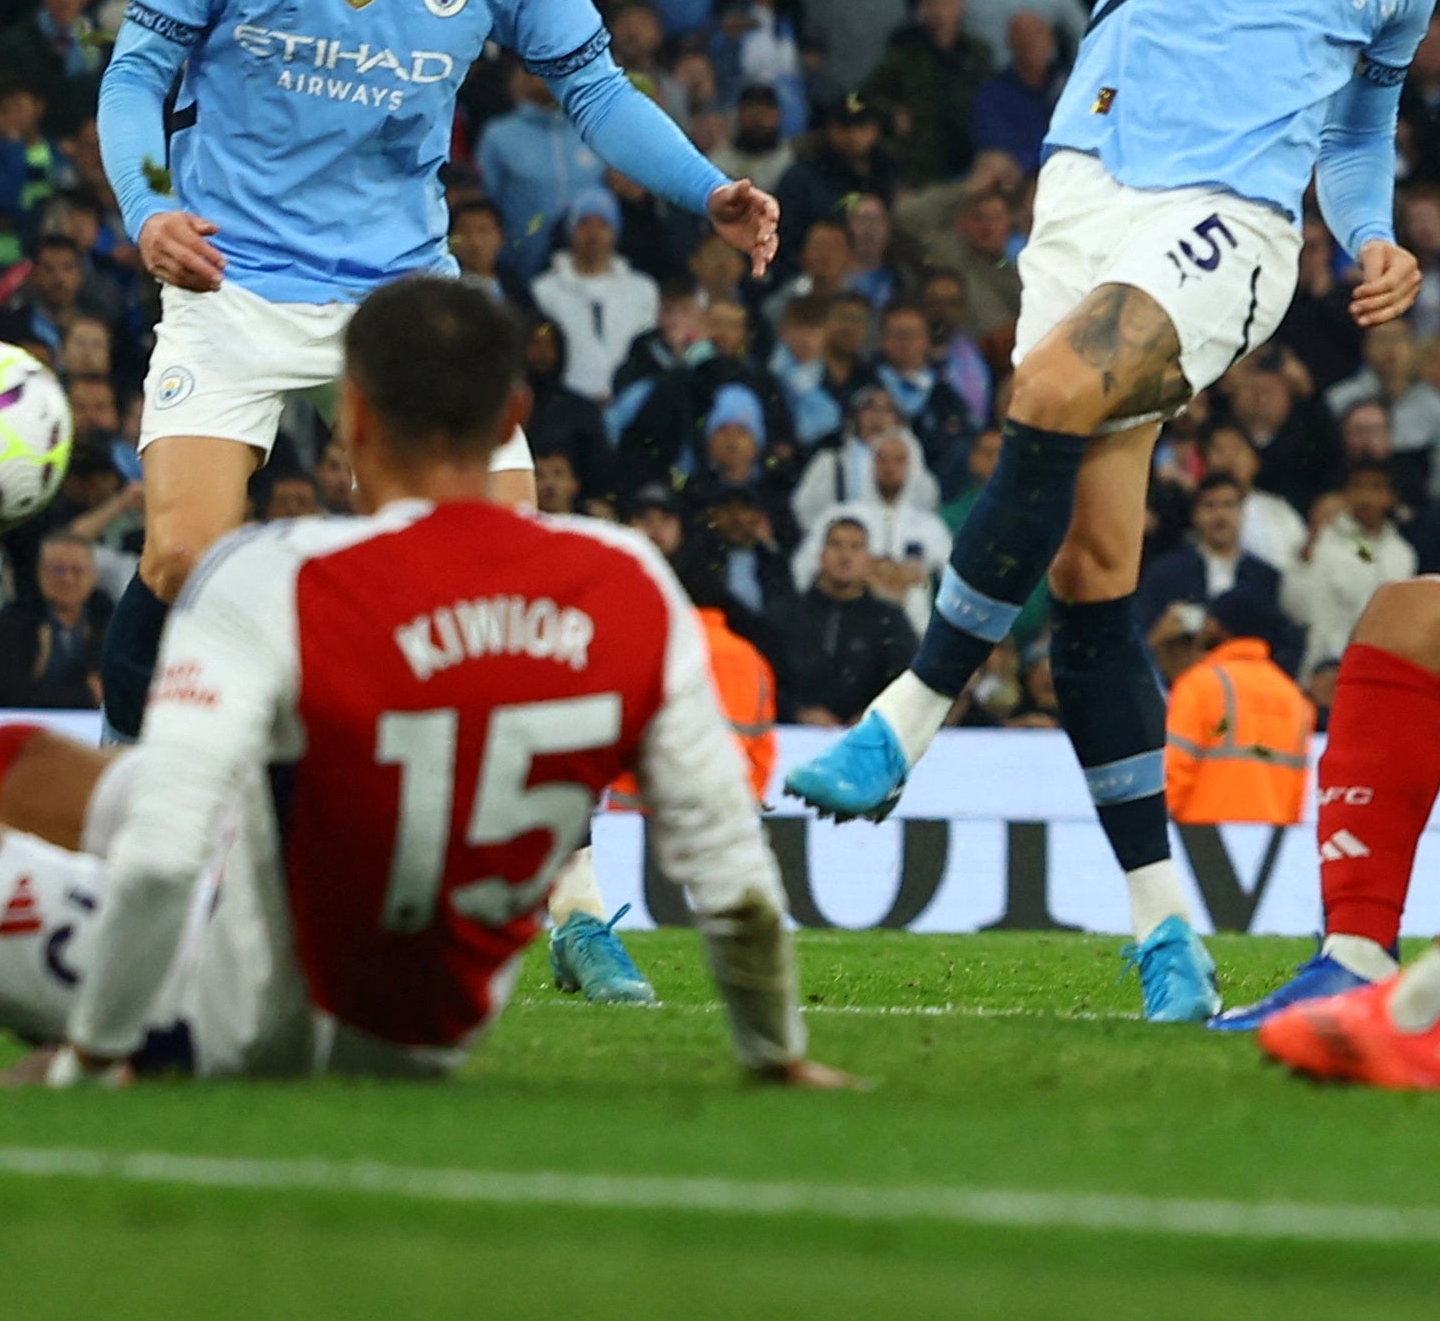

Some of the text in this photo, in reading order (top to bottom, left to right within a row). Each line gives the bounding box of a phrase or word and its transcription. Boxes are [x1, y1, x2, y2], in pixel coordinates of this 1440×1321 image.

[232, 21, 454, 84] ETIHAD
[276, 68, 406, 113] AIRWAYS
[1179, 212, 1237, 274] 5
[394, 593, 595, 681] KIWIOR
[373, 692, 623, 935] 15
